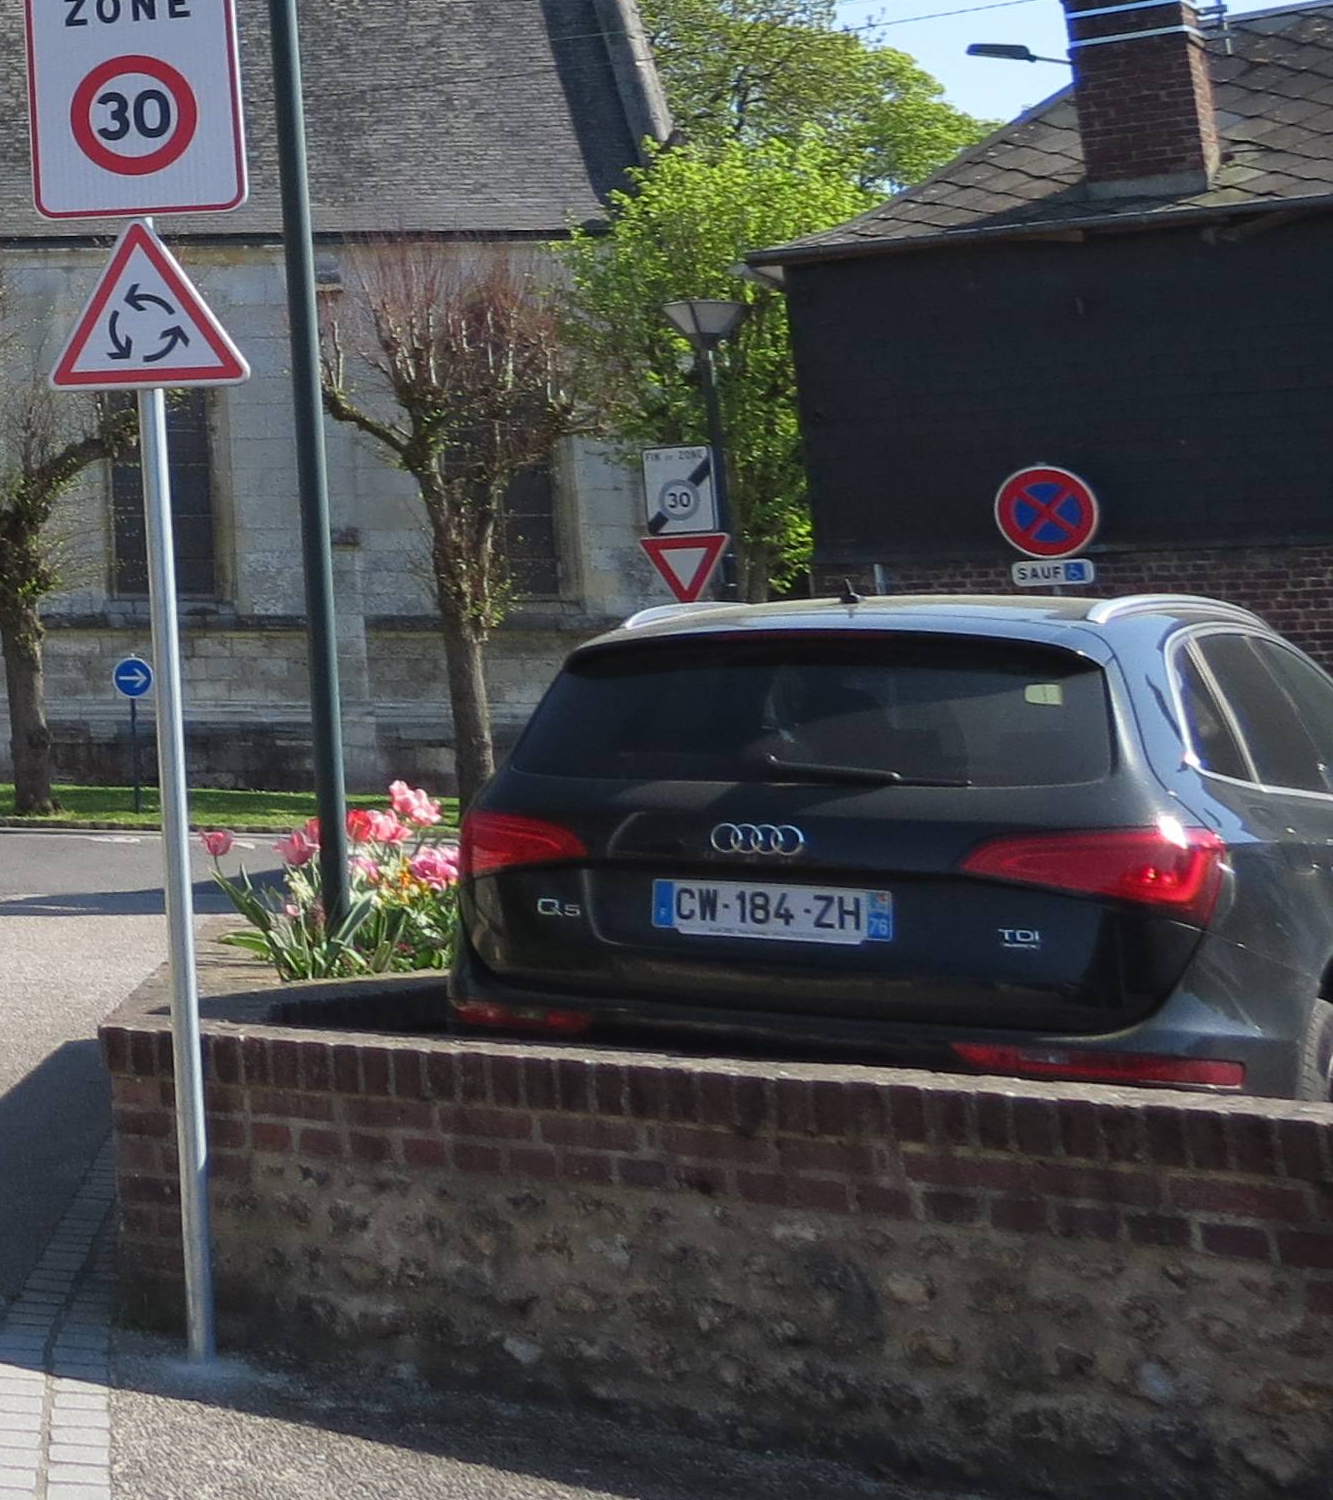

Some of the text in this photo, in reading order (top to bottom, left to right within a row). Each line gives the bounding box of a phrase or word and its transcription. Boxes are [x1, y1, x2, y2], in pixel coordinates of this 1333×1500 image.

[96, 89, 171, 141] 30
[678, 449, 704, 460] ZONE
[668, 491, 691, 508] 30
[1017, 566, 1061, 580] SAUF
[537, 898, 581, 917] Q5
[675, 887, 861, 931] CW-184-ZH
[868, 918, 888, 935] 76
[997, 929, 1039, 941] TDI
